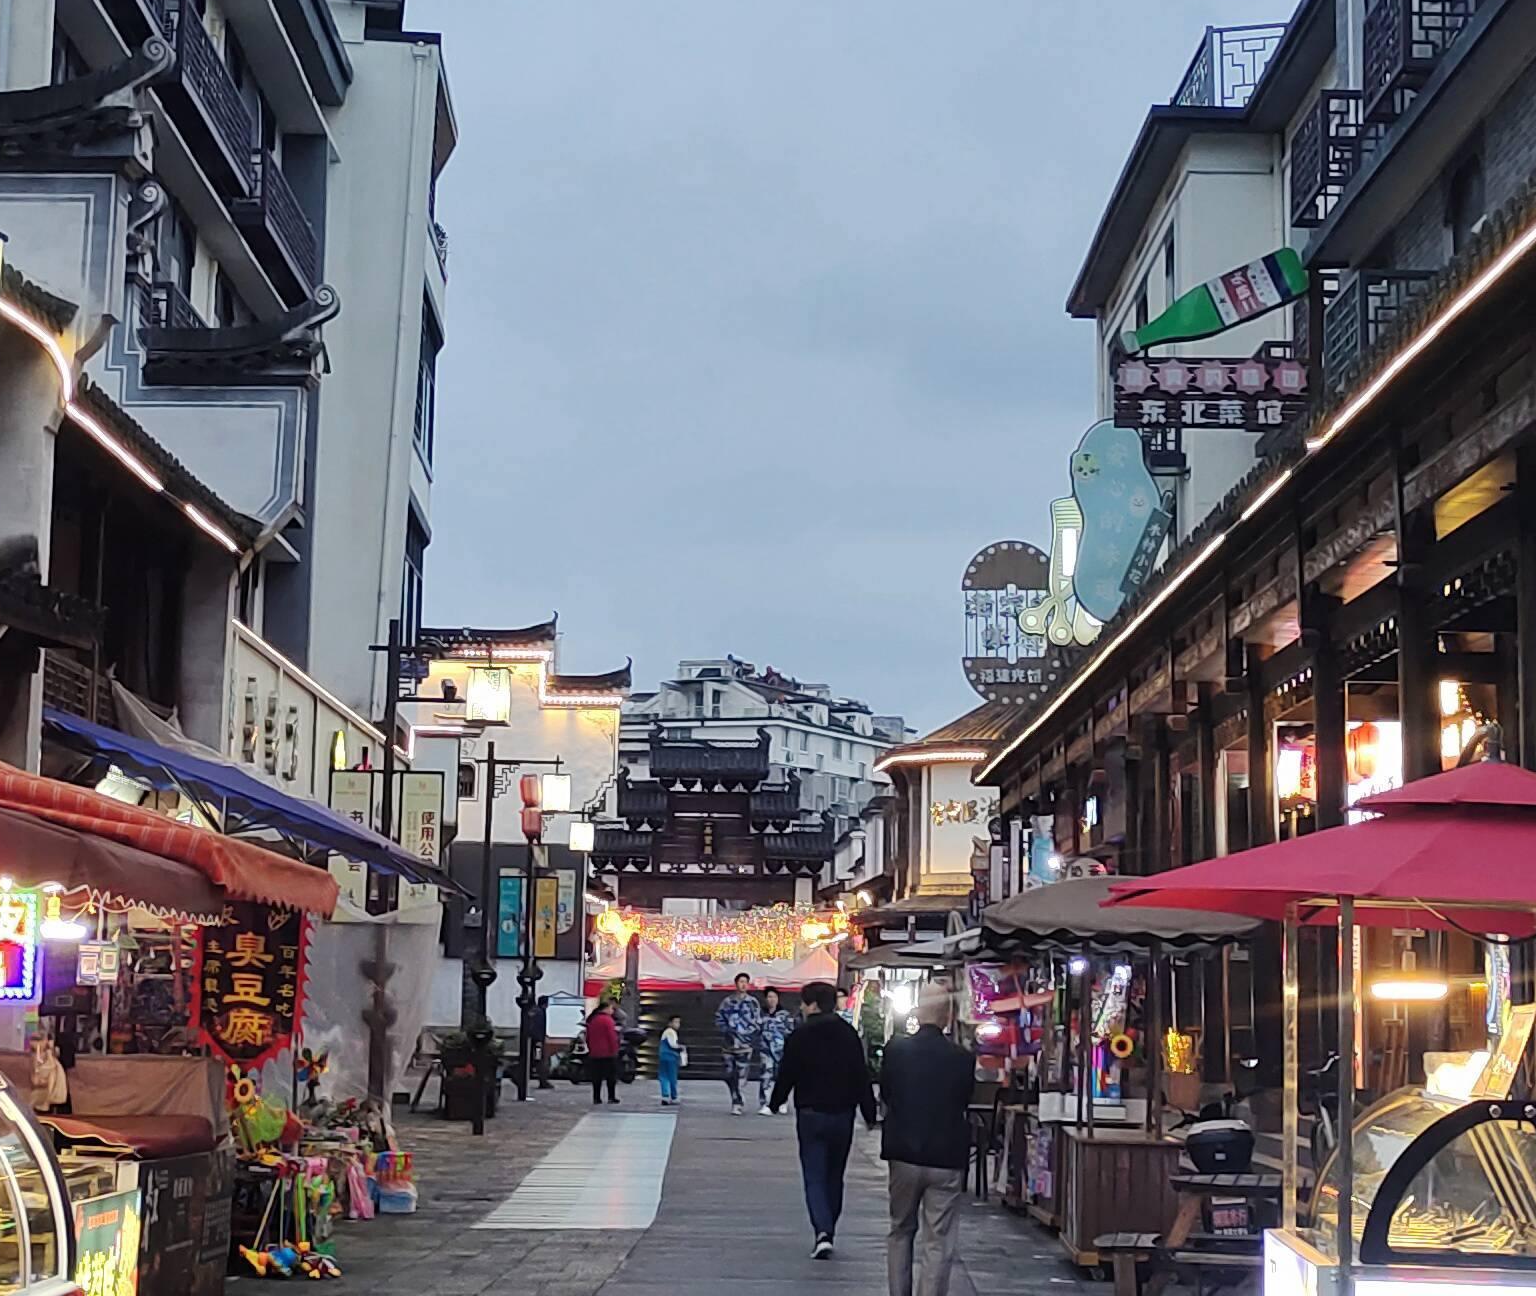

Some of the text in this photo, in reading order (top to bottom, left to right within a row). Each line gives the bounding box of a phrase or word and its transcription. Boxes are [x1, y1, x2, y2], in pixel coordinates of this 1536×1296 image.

[1138, 400, 1286, 425] 东北菜馆
[421, 811, 436, 862] 使用公
[223, 931, 274, 1046] 臭豆腐
